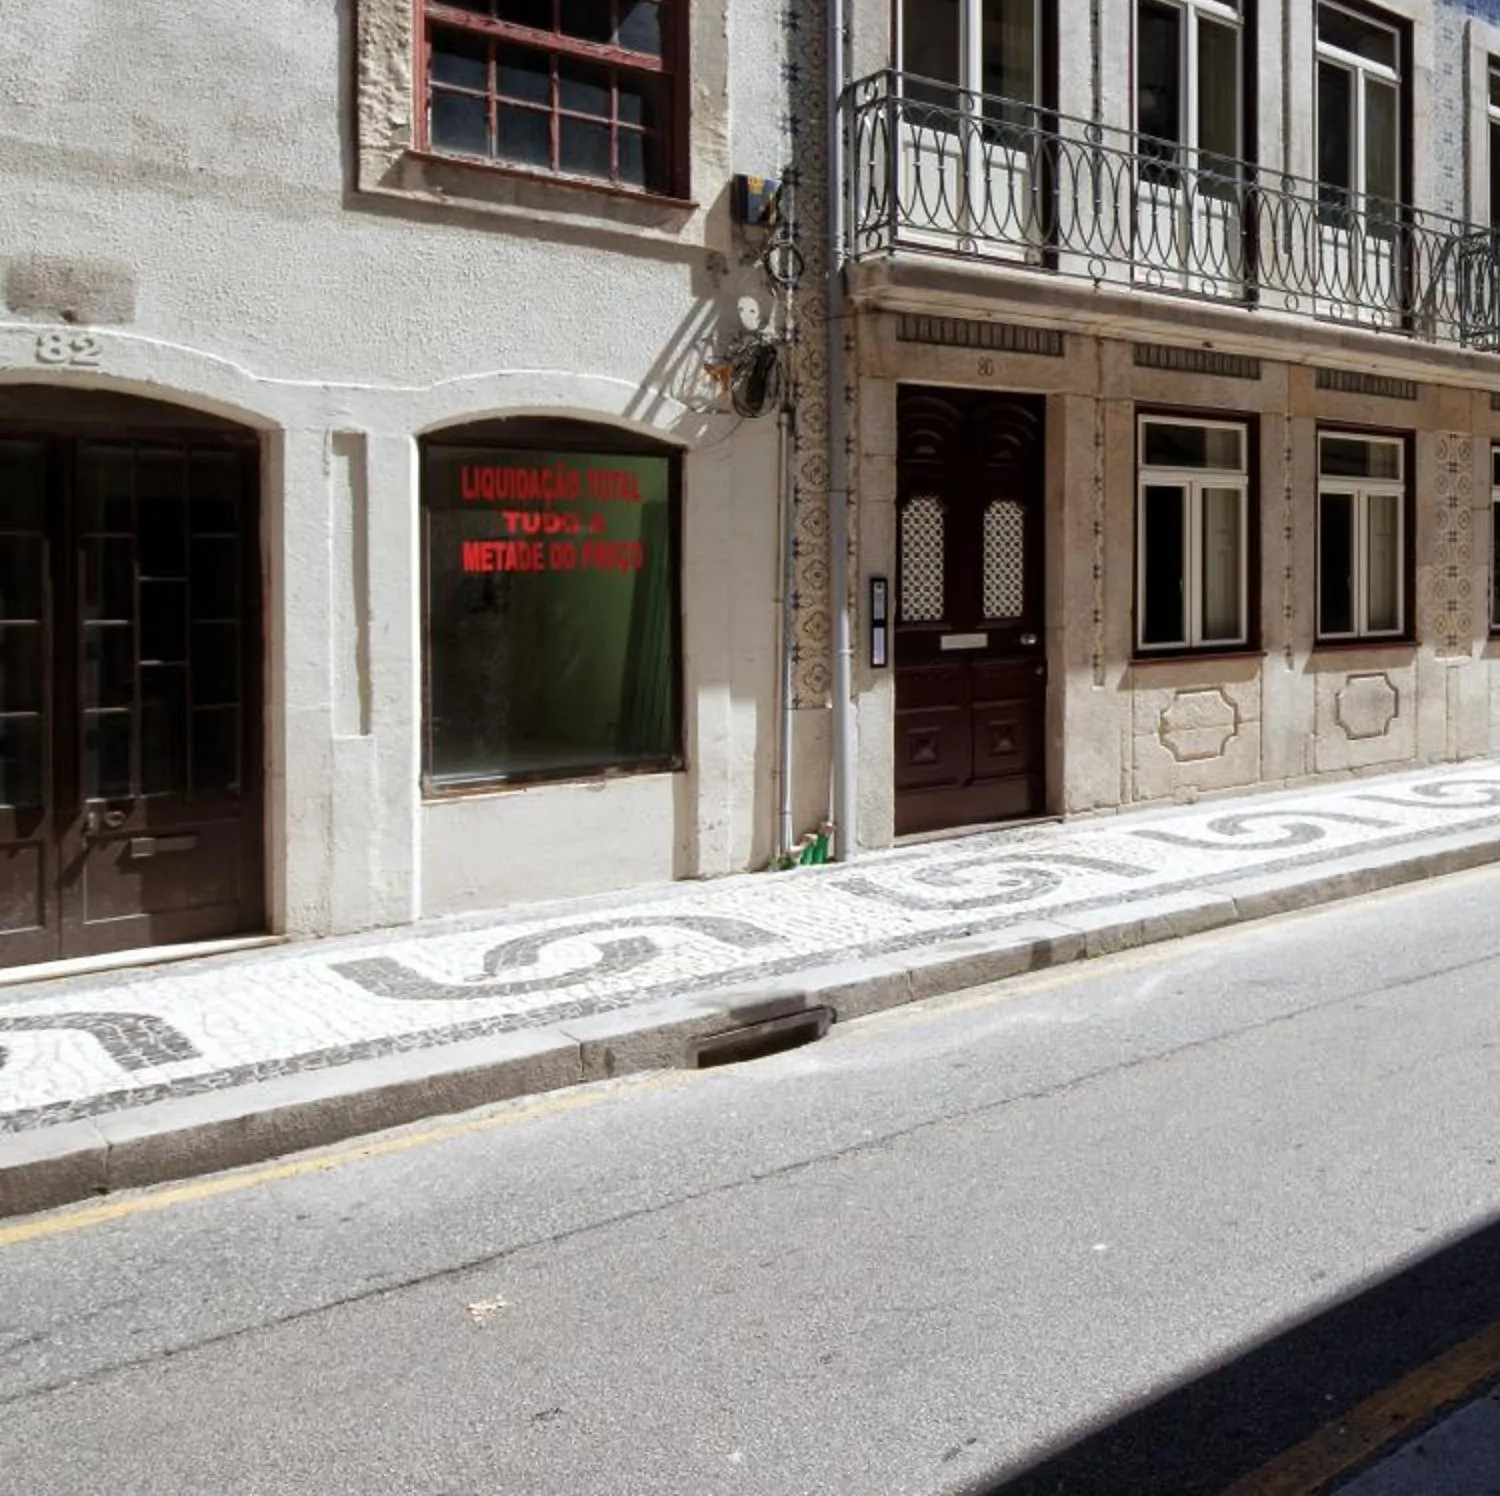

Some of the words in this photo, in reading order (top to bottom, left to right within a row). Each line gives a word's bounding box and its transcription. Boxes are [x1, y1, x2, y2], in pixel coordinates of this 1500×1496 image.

[978, 356, 994, 377] 80
[462, 461, 581, 503] LIQUIDAÇÃO
[503, 511, 581, 535] TUDO
[463, 540, 544, 572] METADE
[549, 542, 576, 571] DO
